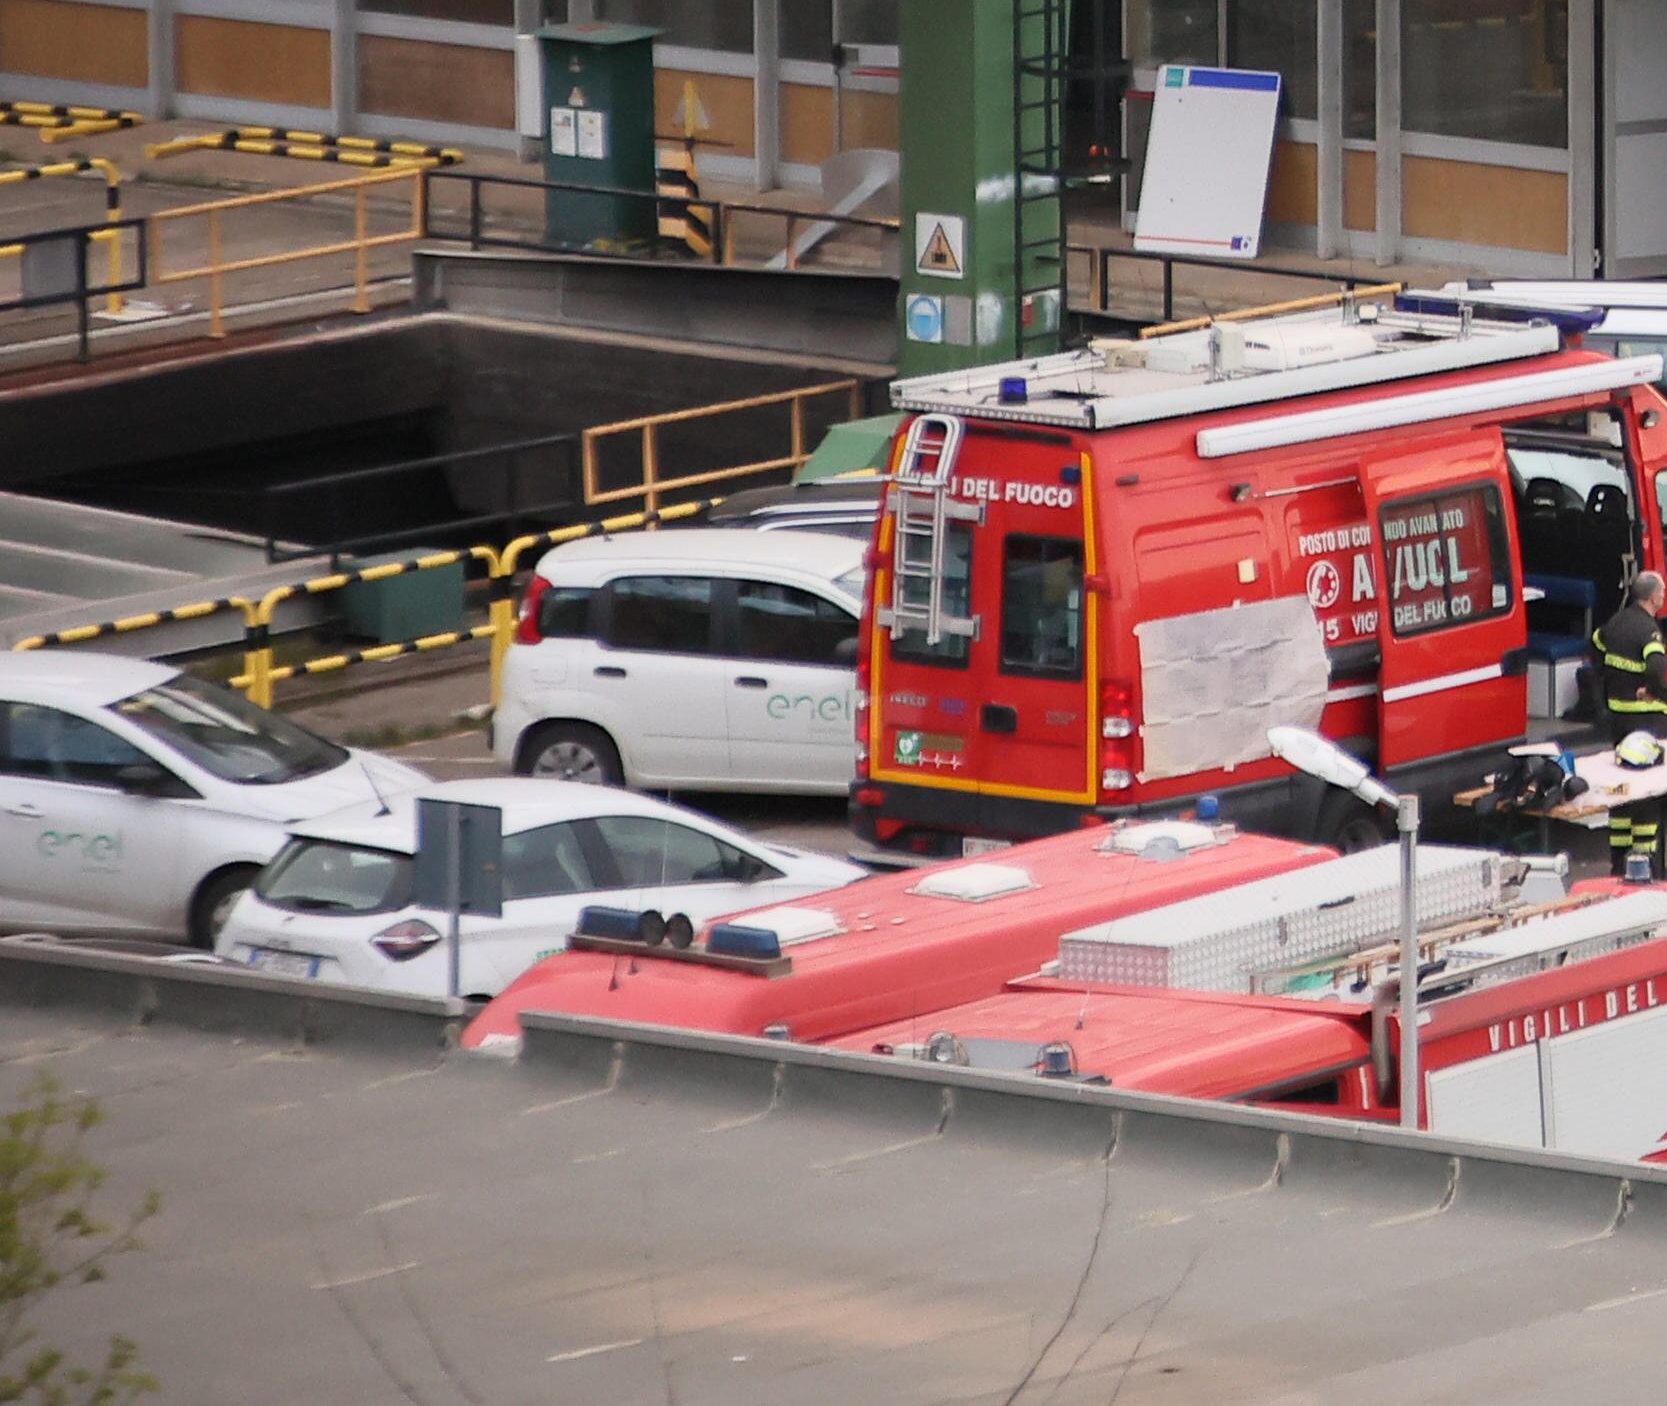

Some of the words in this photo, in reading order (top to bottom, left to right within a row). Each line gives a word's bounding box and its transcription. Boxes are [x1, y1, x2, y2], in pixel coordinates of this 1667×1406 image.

[962, 476, 1000, 502] DEL
[1004, 481, 1074, 509] FUOCO
[1299, 530, 1337, 557] POSTO
[1337, 528, 1351, 549] DI
[1409, 508, 1464, 537] AVANATO
[1393, 602, 1422, 629] DEL
[766, 690, 852, 722] enel
[1488, 999, 1585, 1052] VIGILI
[1605, 979, 1658, 1020] DEL
